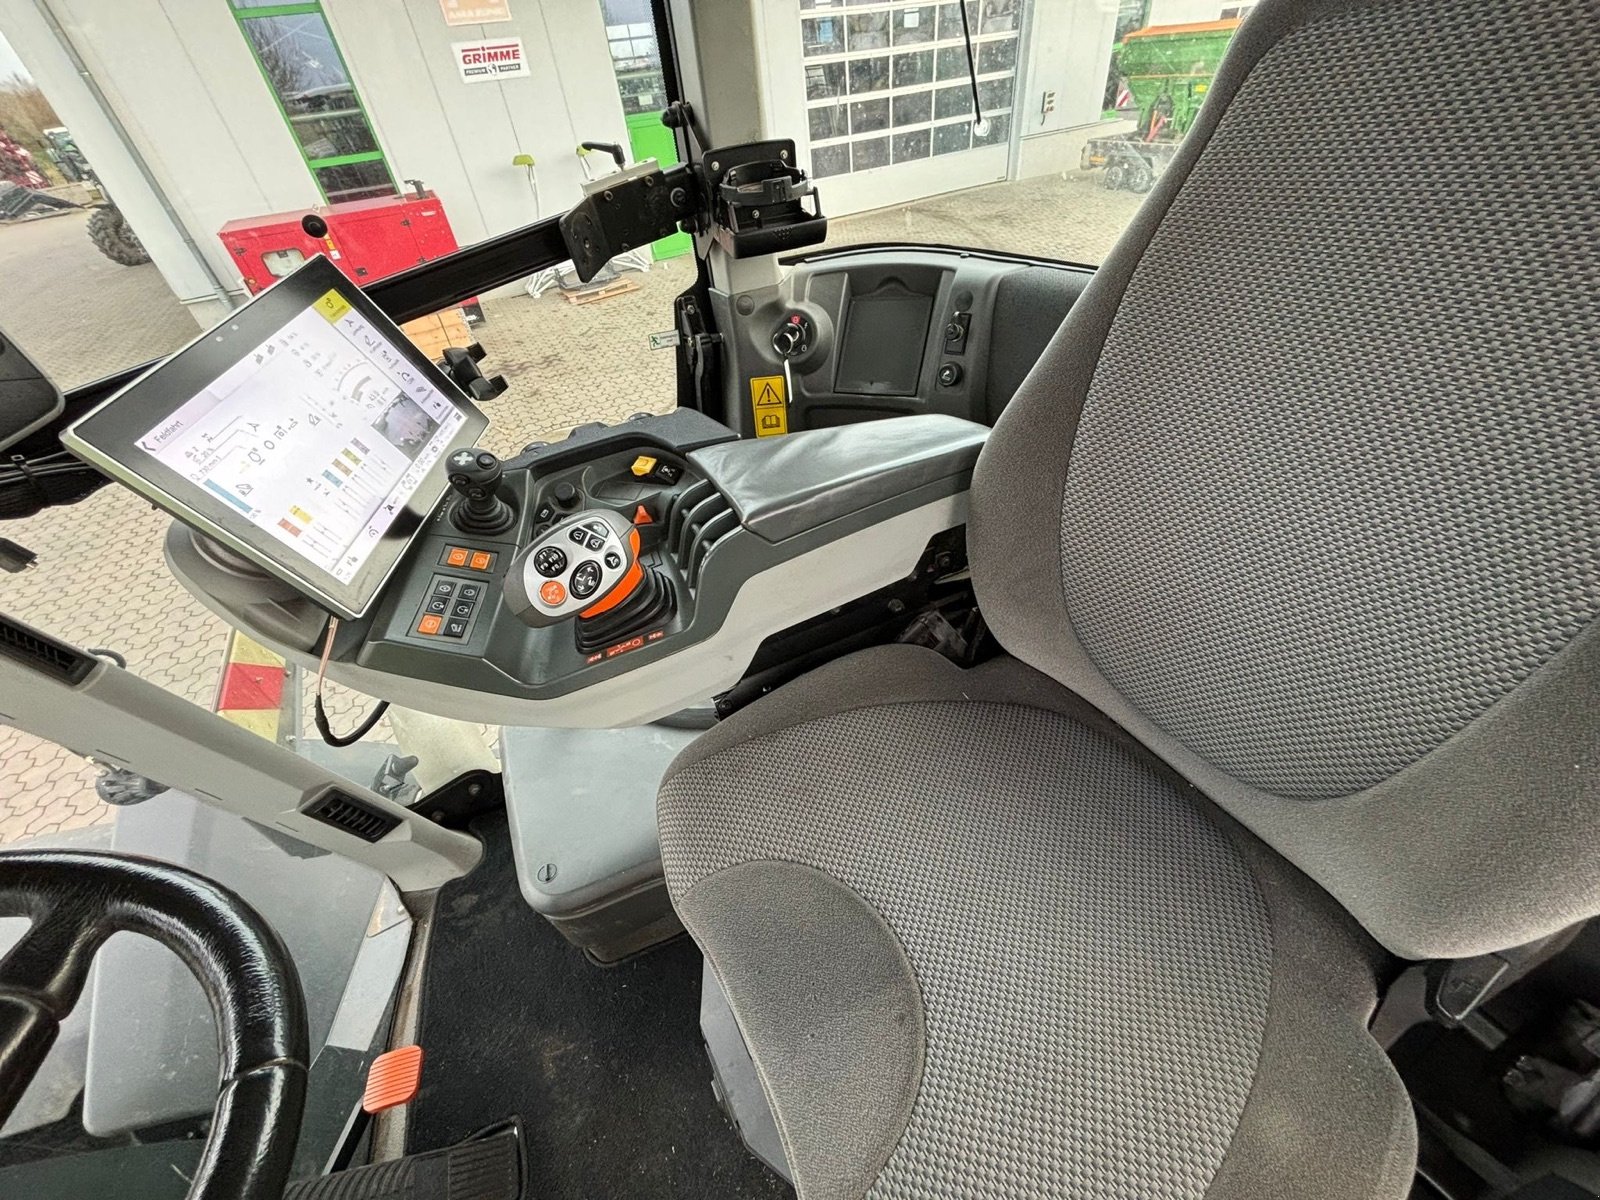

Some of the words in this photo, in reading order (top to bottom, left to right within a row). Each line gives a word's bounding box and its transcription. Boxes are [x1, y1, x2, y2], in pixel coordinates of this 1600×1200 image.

[462, 48, 520, 65] GRIMME
[465, 67, 486, 75] PREMIUM
[153, 420, 184, 444] Feldfahrt
[548, 552, 559, 563] F10
